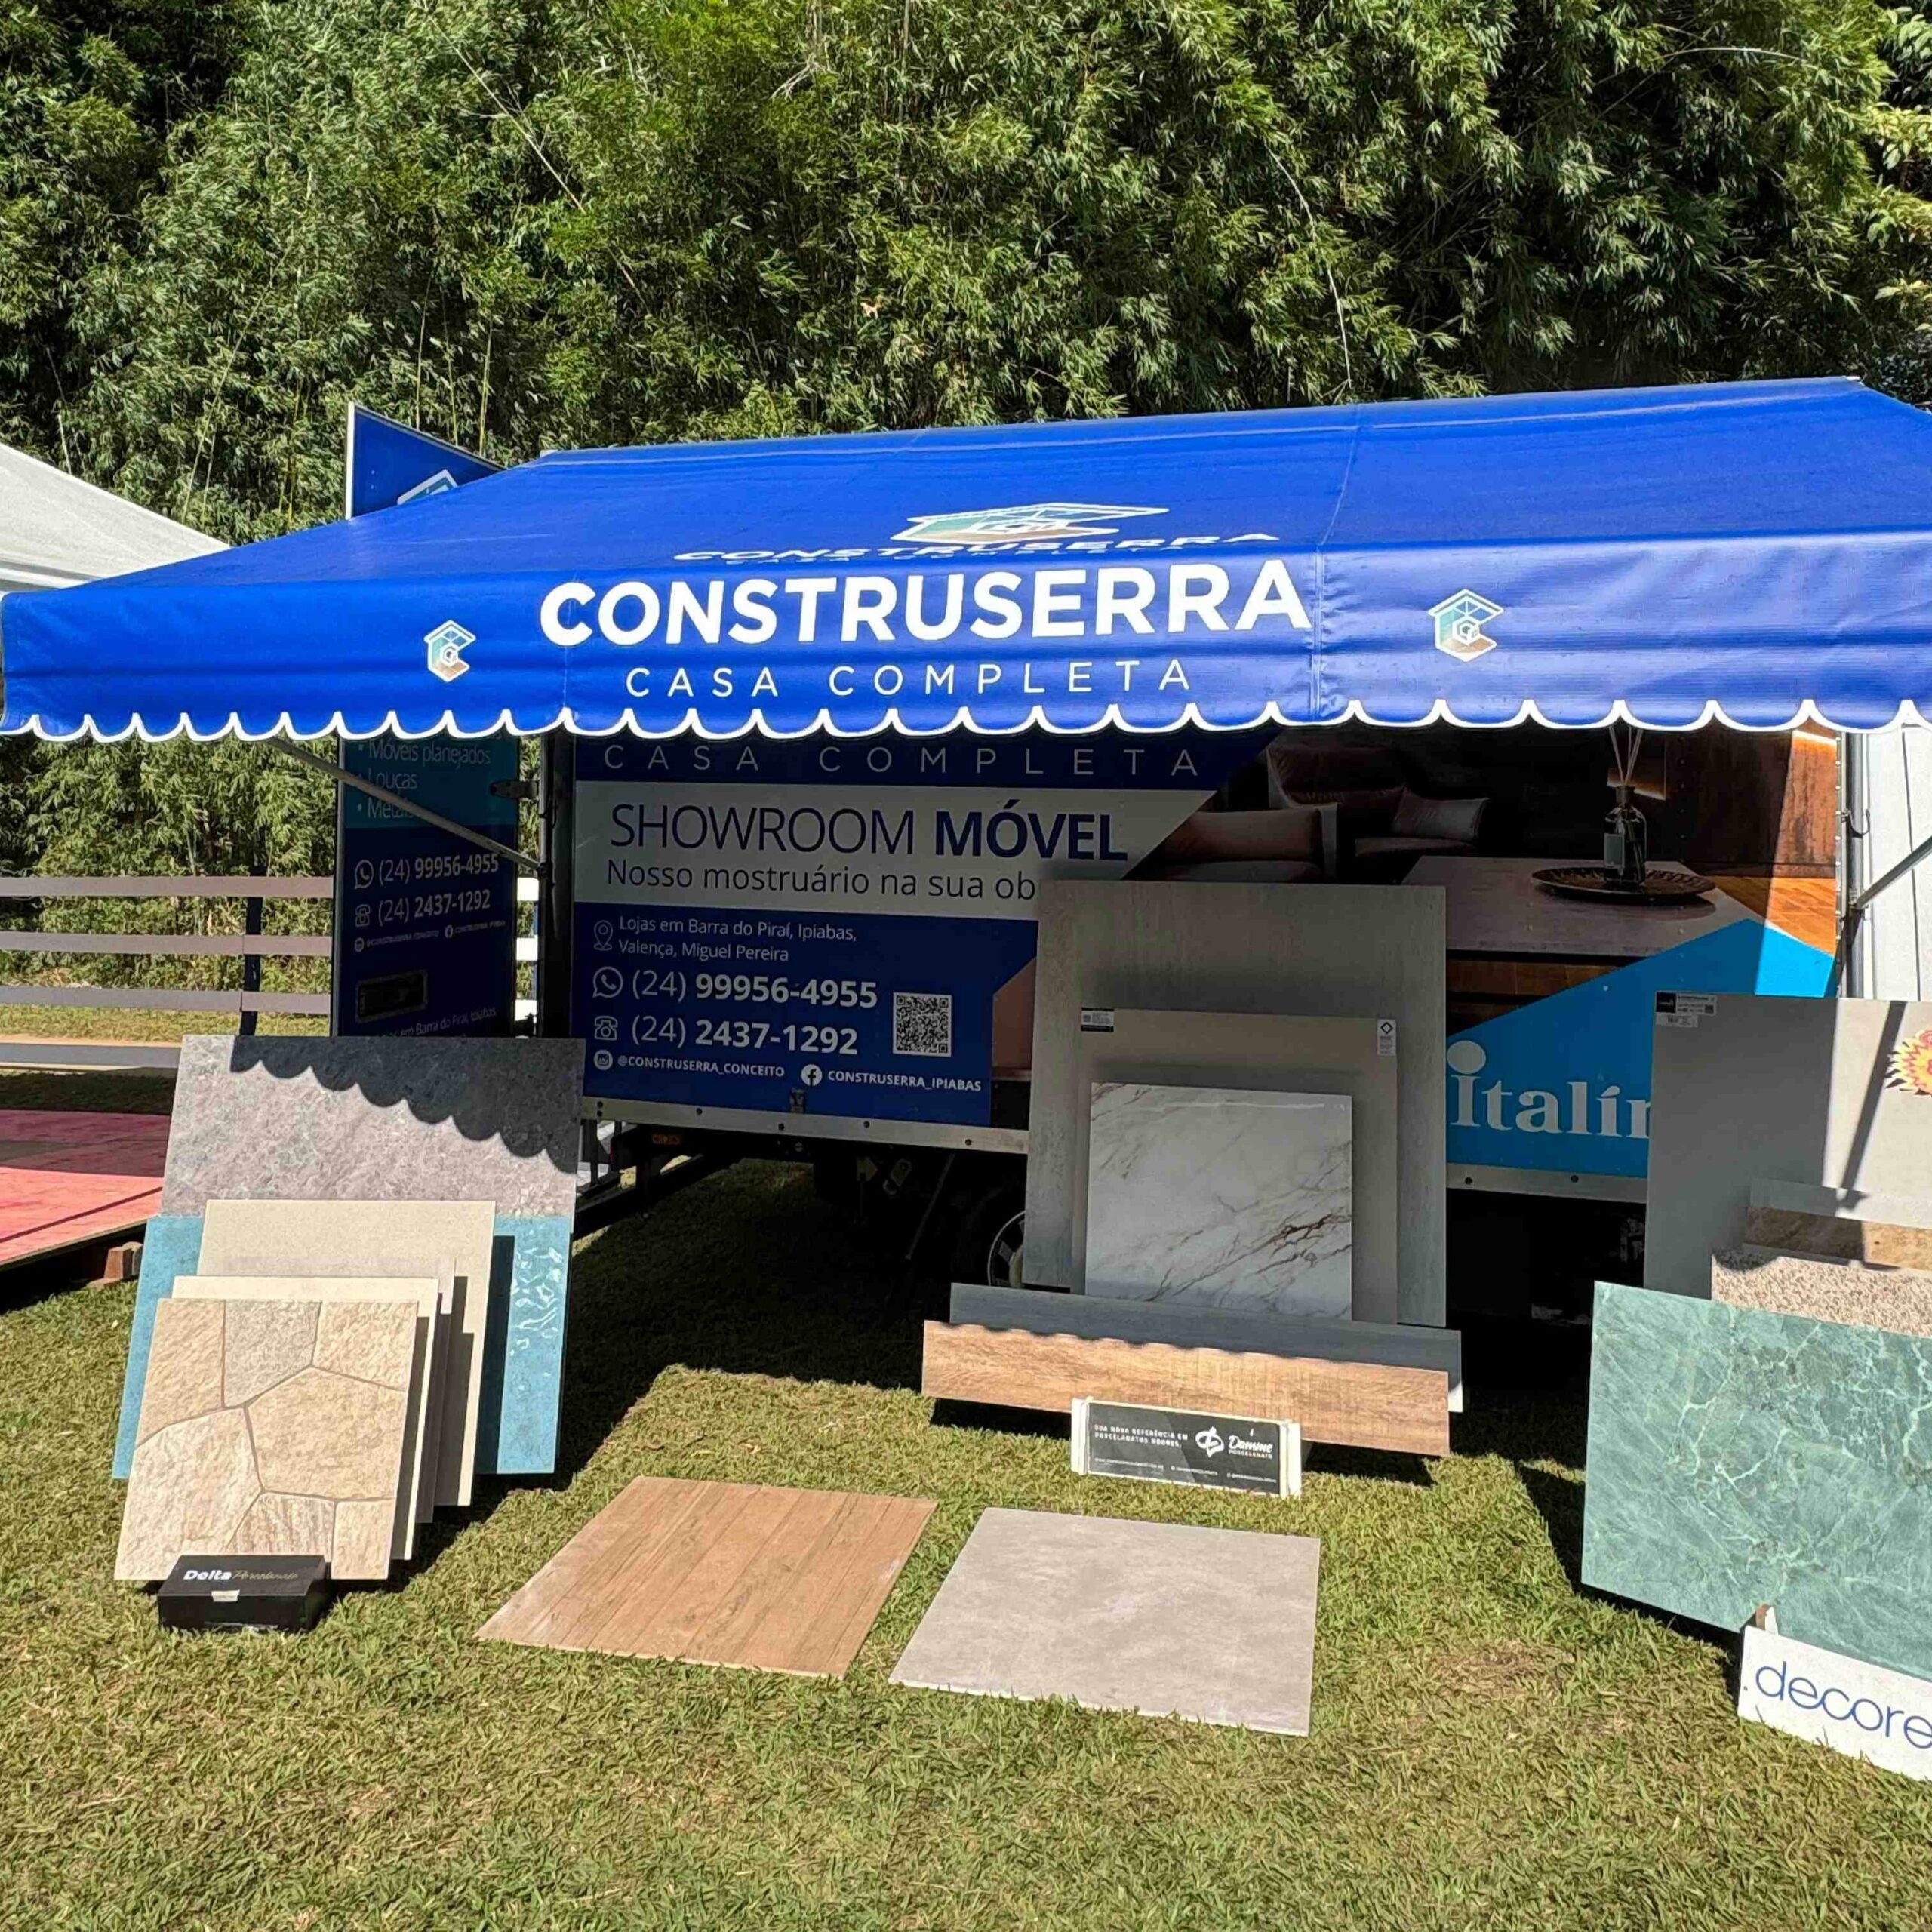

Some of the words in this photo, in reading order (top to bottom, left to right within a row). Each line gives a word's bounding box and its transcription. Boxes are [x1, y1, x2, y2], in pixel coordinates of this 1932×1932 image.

[673, 533, 1280, 560] CONSTRUSERRA
[539, 559, 1312, 647] CONSTRUSERRA
[625, 666, 778, 697] CASA
[829, 659, 1189, 696] COMPLETA
[368, 737, 419, 763] Móveis
[421, 742, 491, 770] planejados
[604, 746, 759, 771] CASA
[819, 747, 1198, 777] COMPLETA
[368, 797, 414, 819] Meta
[610, 803, 914, 855] SHOWROOM
[936, 798, 1128, 861] MÓVEL
[379, 859, 411, 887] (24)
[414, 853, 499, 880] 99956-4955
[607, 859, 693, 888] Nosso
[703, 862, 869, 896] mostruário
[881, 875, 918, 897] na
[928, 875, 983, 899] sua
[995, 870, 1035, 900] ob
[378, 897, 410, 927] (24)
[414, 889, 491, 918] 2437-1292
[619, 915, 656, 934] Lojas
[660, 921, 684, 933] em
[688, 918, 729, 934] Barra
[733, 921, 753, 936] do
[758, 921, 793, 940] Piraí,
[798, 923, 857, 942] Ipiabas,
[618, 939, 678, 959] Valença,
[681, 943, 731, 961] Miguel
[736, 945, 789, 961] Pereira
[632, 971, 686, 1002] (24)
[695, 973, 878, 1009] 99956-4955
[631, 1015, 686, 1047] (24)
[694, 1019, 859, 1055] 2437-1292
[617, 1055, 785, 1078] @CONSTRUSERRA_CONCEITO
[828, 1069, 982, 1092] CONSTRUSERRA_IPIABAS
[183, 1569, 232, 1580] Delta
